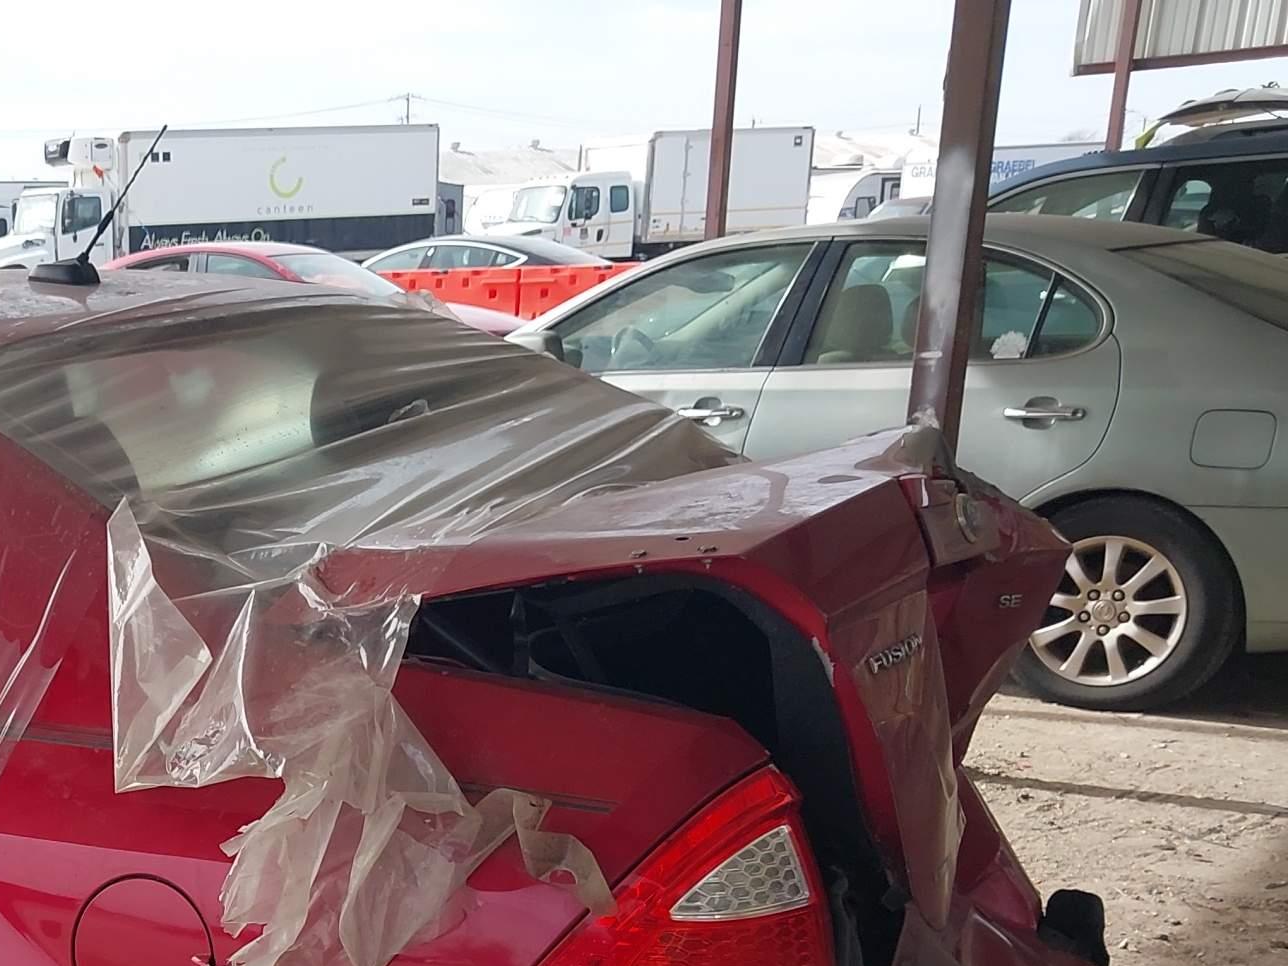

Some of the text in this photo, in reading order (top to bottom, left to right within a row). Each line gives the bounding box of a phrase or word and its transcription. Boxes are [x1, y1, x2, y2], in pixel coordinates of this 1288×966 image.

[257, 204, 314, 216] canteen
[999, 594, 1024, 608] SE
[869, 632, 923, 674] FUSION
